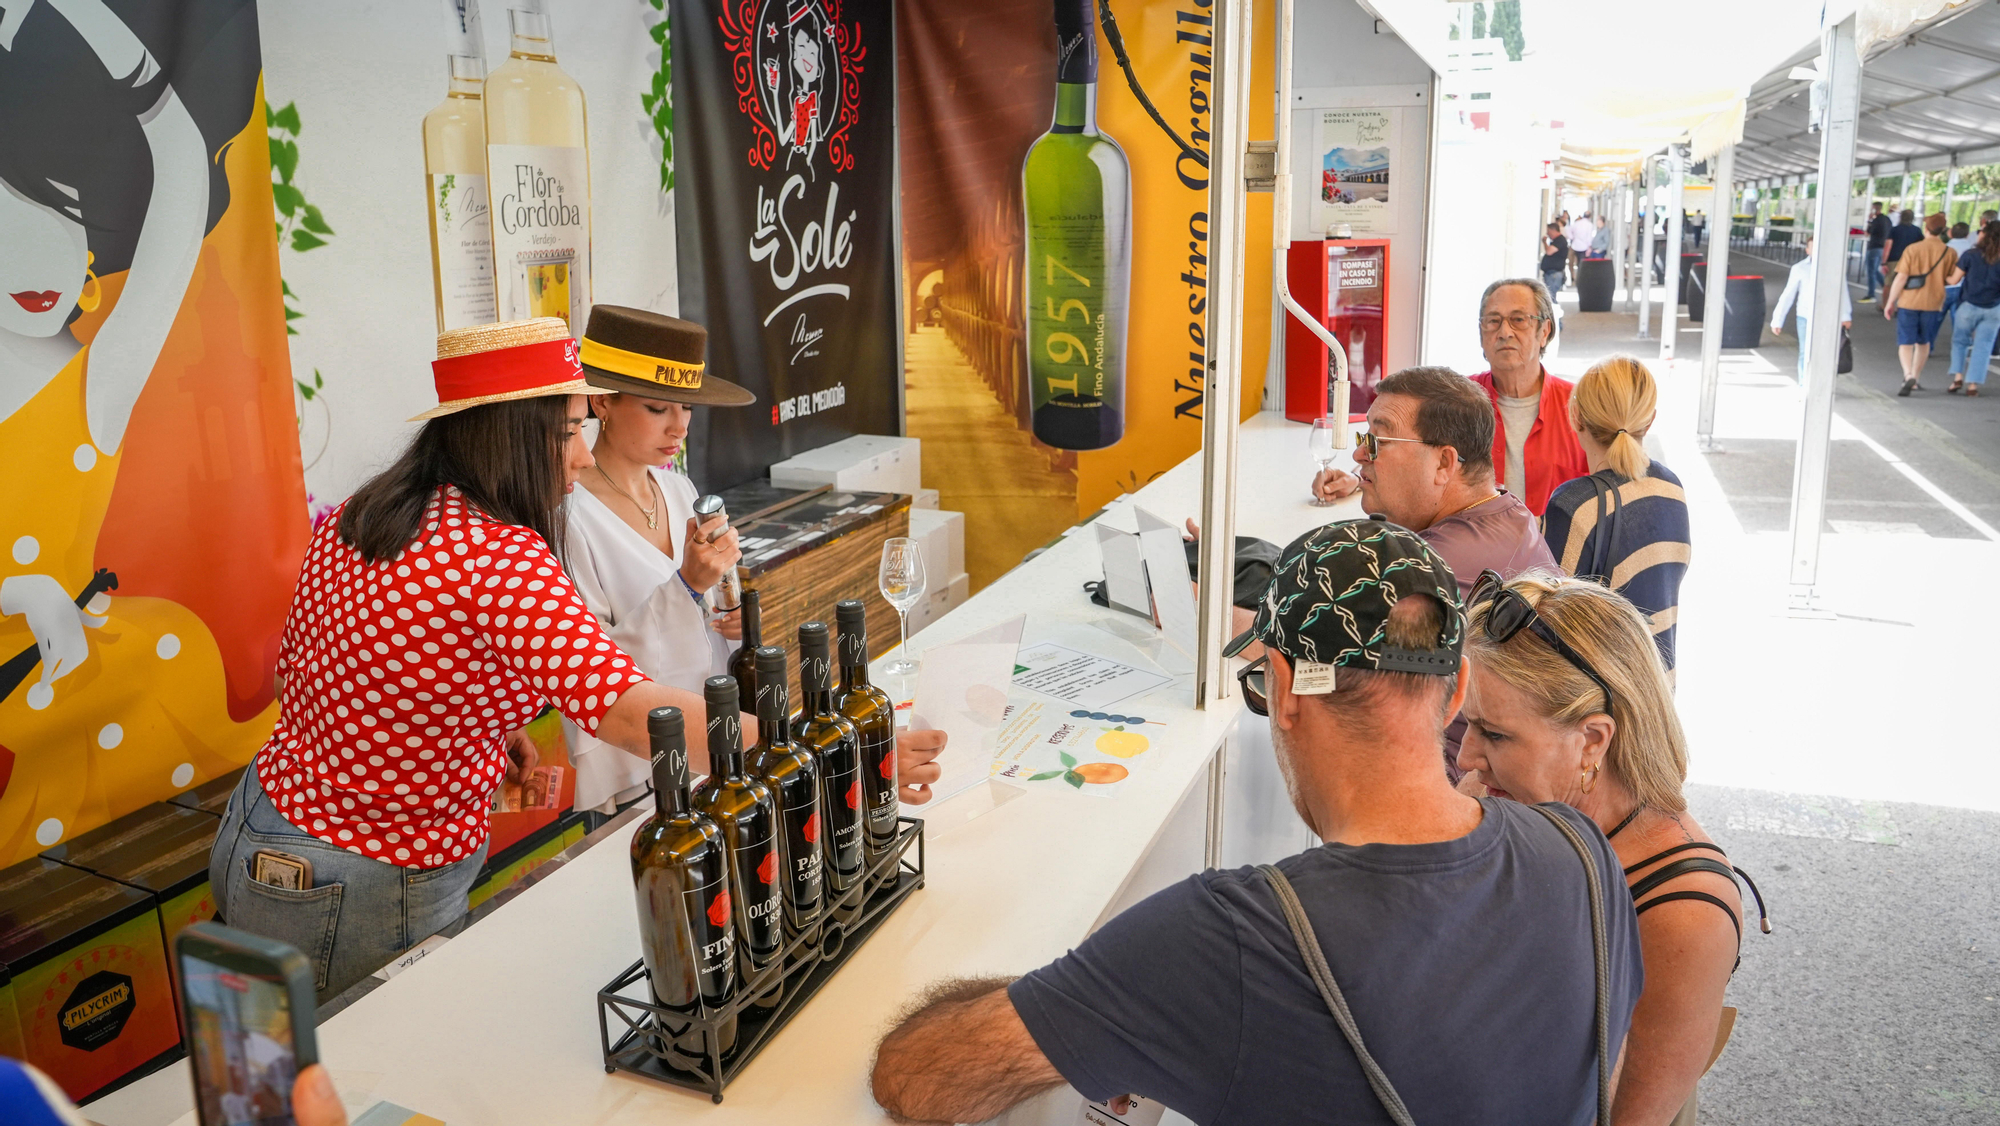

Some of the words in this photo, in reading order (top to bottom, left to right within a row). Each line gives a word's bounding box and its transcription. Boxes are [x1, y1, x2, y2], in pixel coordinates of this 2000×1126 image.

[1176, 0, 1213, 191] Orgull
[515, 165, 556, 202] Flor
[478, 239, 490, 247] Córd
[531, 235, 557, 246] Verdejo
[750, 174, 857, 290] Solé
[1342, 261, 1373, 269] ROMPASE
[1342, 278, 1372, 286] INCENDIO
[1047, 254, 1091, 397] 1957
[1174, 211, 1209, 420] Nuestro
[1094, 313, 1105, 371] Andalucía
[1094, 372, 1103, 397] Fino
[798, 394, 811, 417] DEL
[797, 849, 822, 872] PAL
[702, 963, 722, 975] Solera
[70, 988, 123, 1023] PILYCRIM
